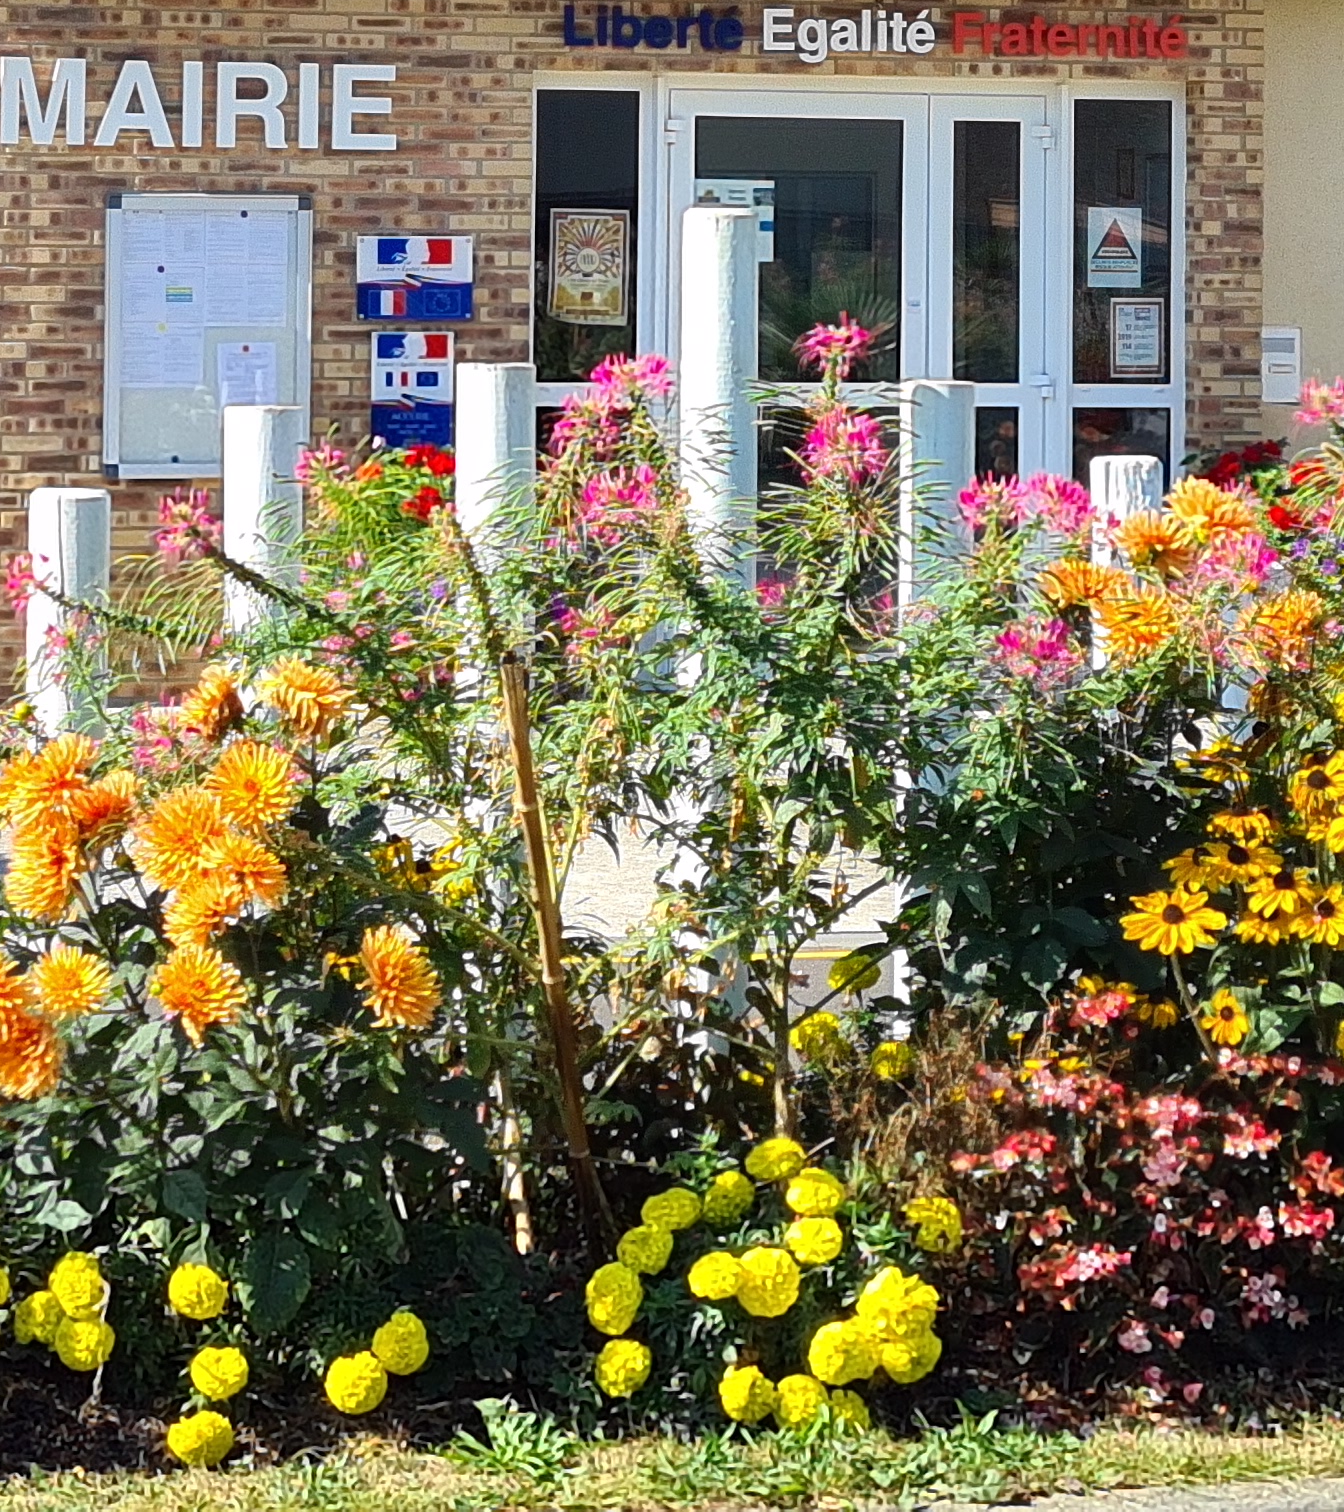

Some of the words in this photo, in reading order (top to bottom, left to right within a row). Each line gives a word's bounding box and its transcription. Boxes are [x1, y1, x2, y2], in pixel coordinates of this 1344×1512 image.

[563, 5, 743, 50] Liberté
[762, 8, 936, 63] Egalité
[952, 12, 1189, 59] Fraternité
[0, 55, 398, 151] MAIRIE
